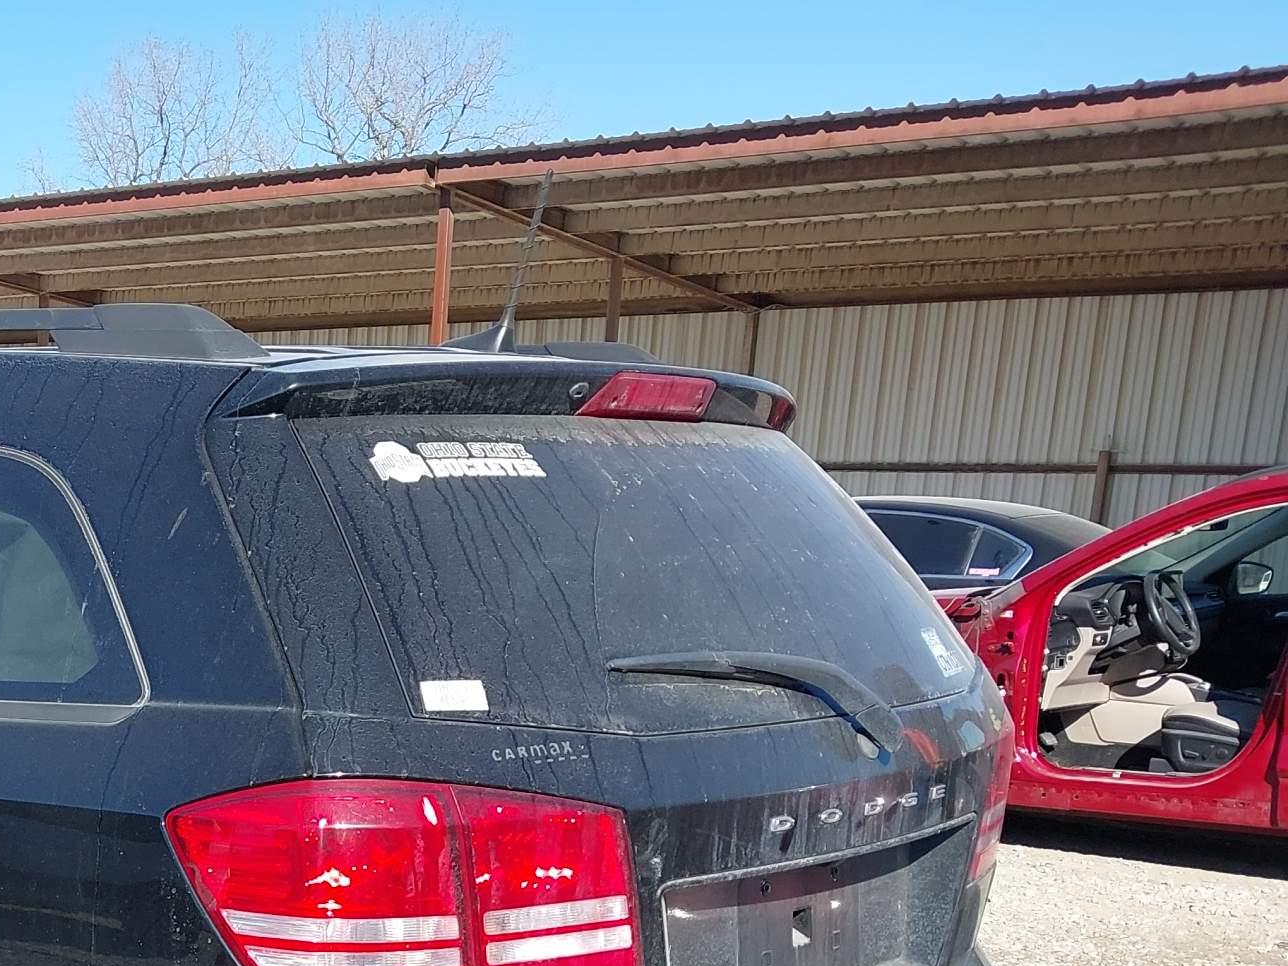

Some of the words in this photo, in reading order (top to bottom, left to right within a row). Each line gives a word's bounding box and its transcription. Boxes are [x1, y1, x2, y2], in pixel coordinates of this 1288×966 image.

[416, 442, 469, 458] OHIO
[467, 442, 533, 458] STATE
[426, 459, 547, 478] BUCKEYES
[769, 783, 947, 833] DODGE
